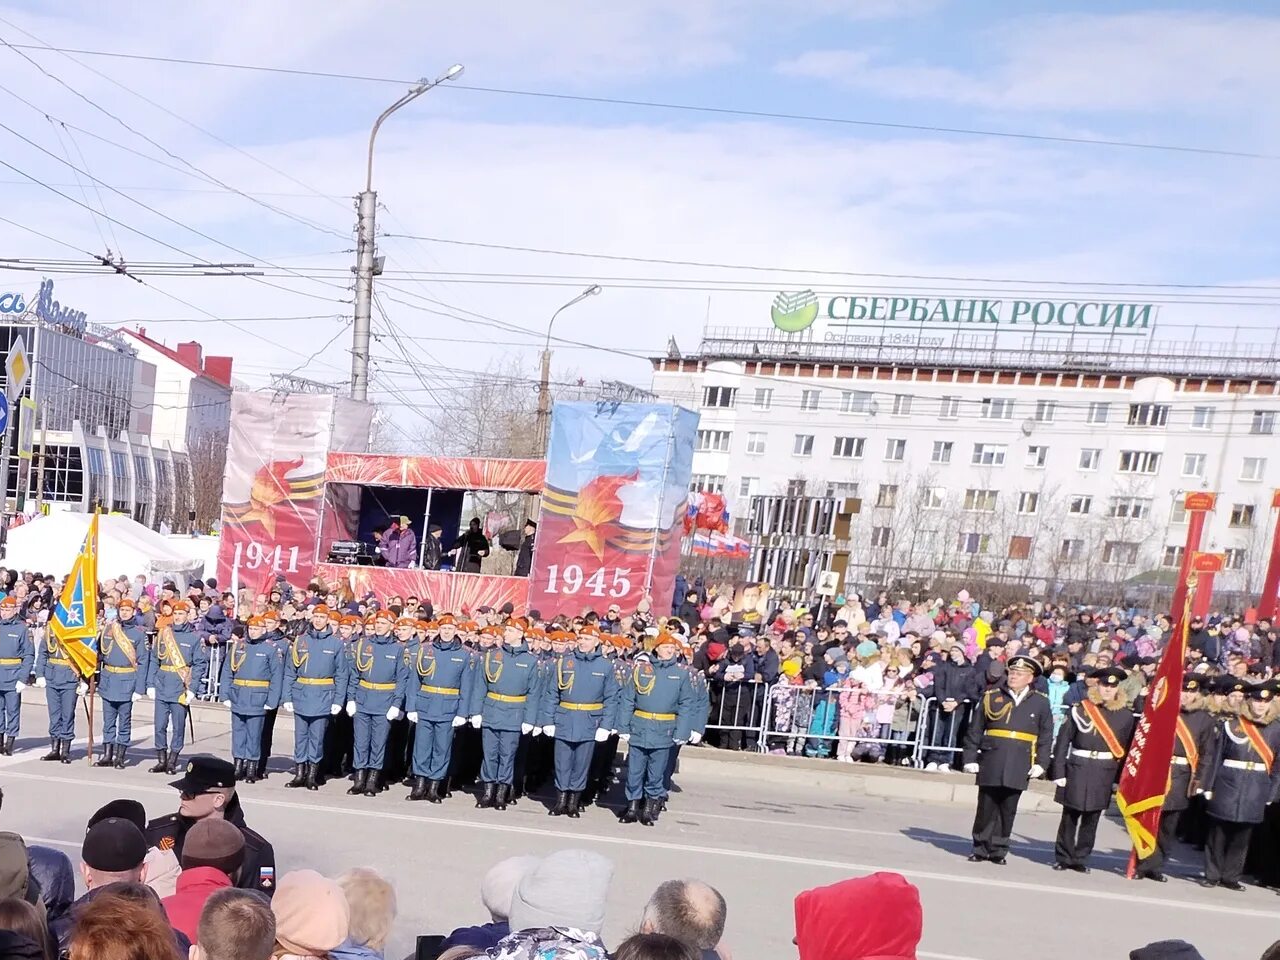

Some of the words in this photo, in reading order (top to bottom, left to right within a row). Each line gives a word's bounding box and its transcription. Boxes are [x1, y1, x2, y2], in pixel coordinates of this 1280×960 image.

[827, 296, 1003, 324] СБЕРБАНК
[1010, 300, 1153, 329] РОССИИ
[889, 333, 916, 344] 1841
[232, 541, 299, 573] 1941
[544, 564, 632, 598] 1945
